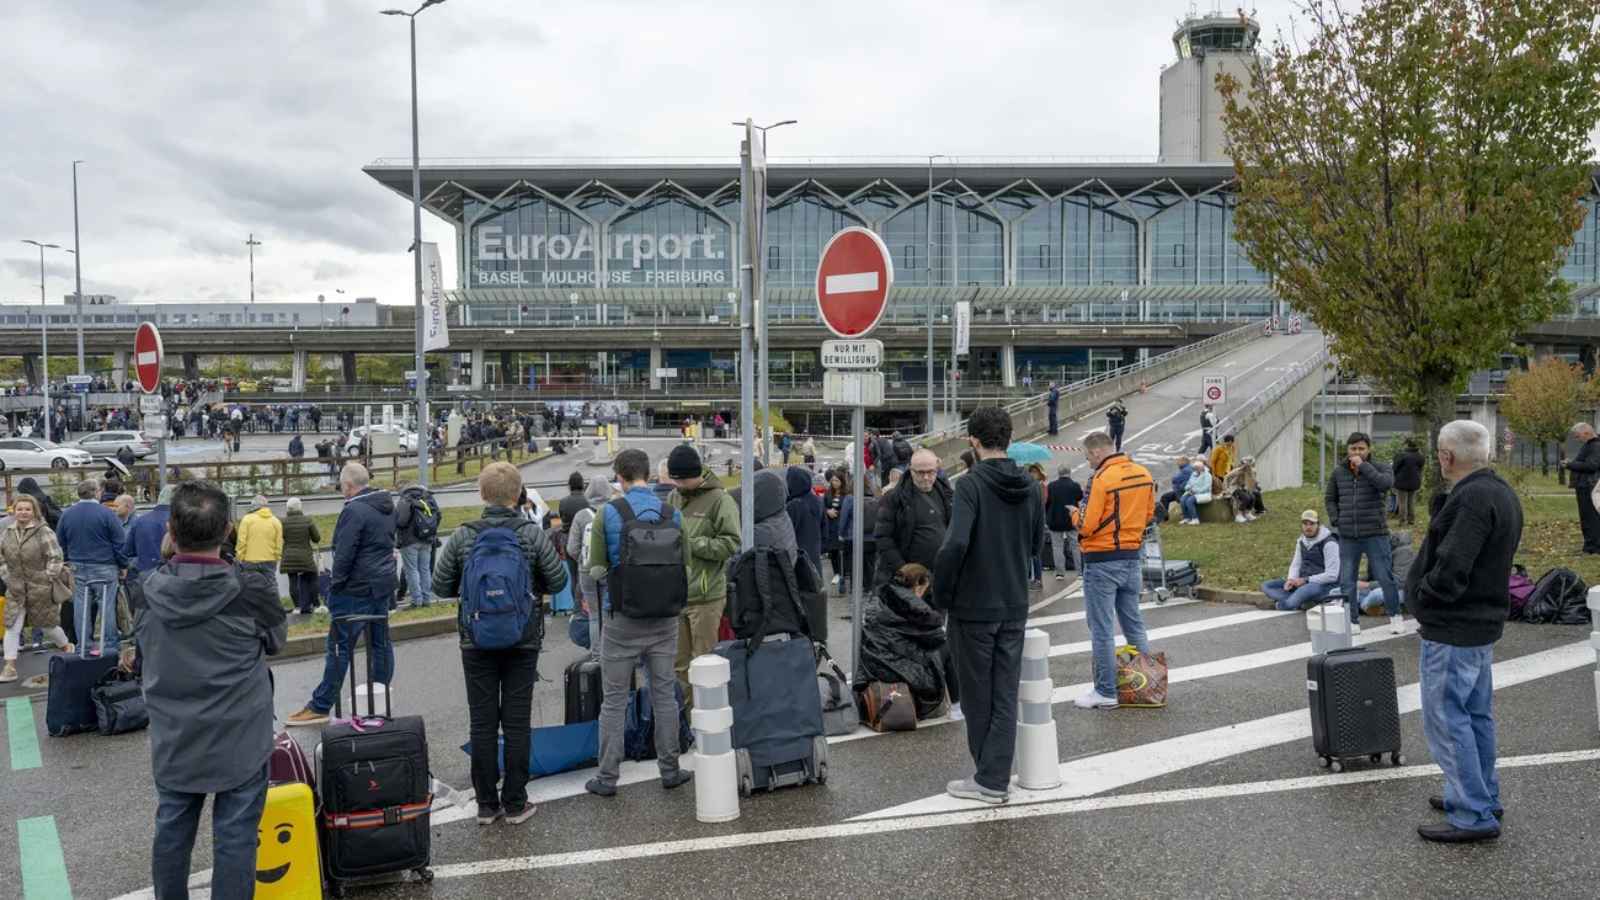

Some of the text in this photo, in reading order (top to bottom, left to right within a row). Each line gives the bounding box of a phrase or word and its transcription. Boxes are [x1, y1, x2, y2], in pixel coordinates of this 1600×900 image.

[479, 271, 725, 284] BASEL MULHOSE FREIBURG
[834, 344, 865, 353] NUR MIT
[824, 355, 877, 364] BEWILLIGUNG
